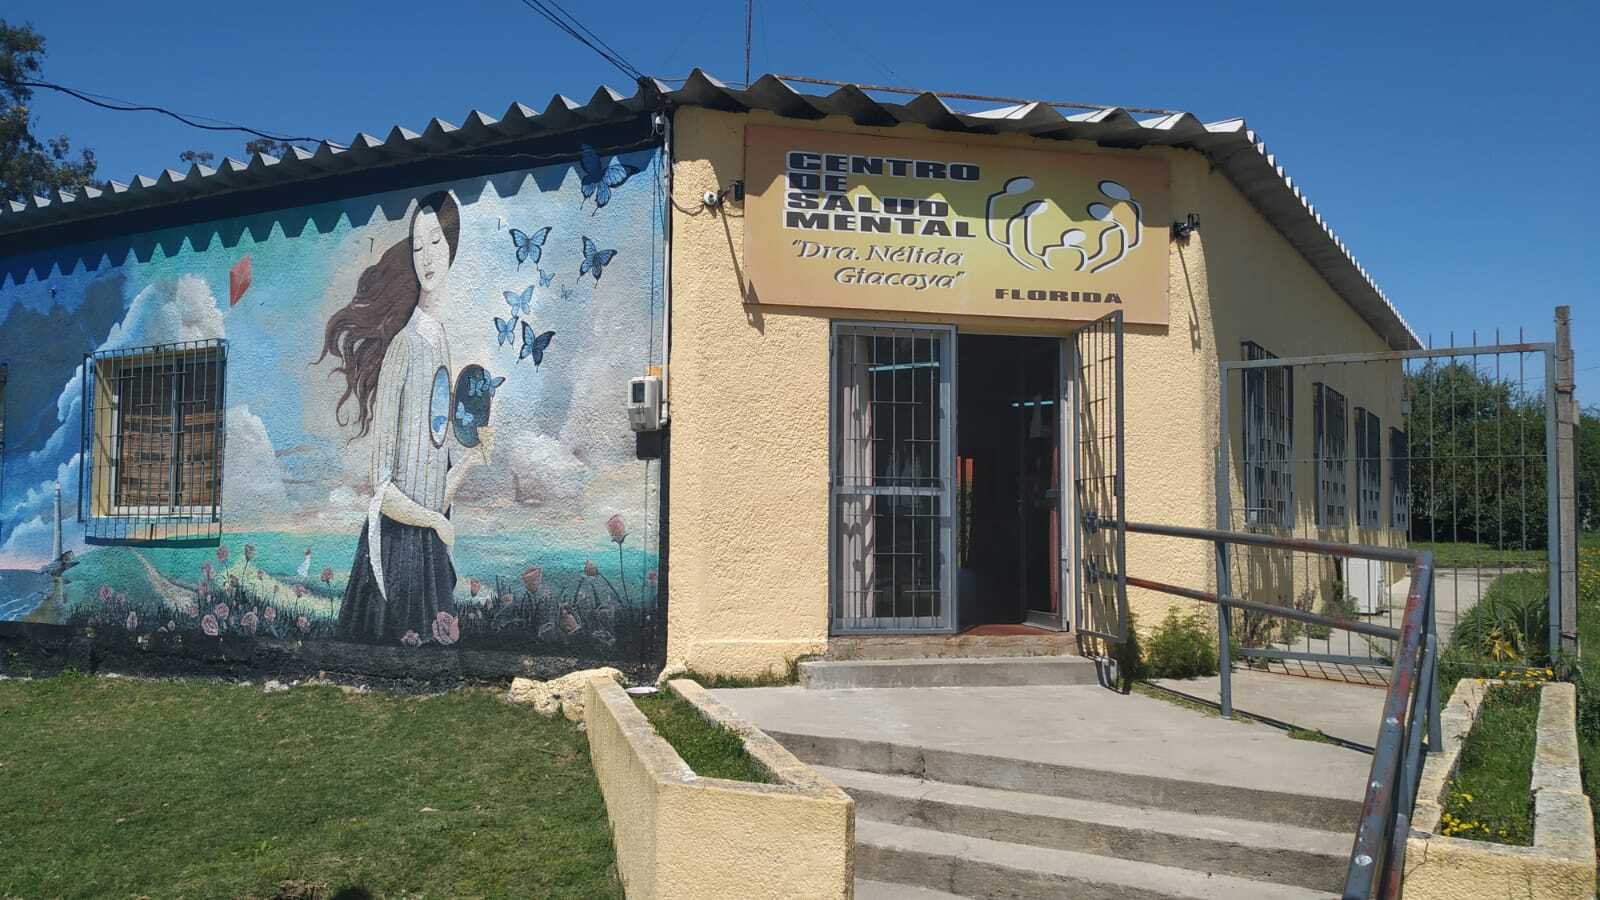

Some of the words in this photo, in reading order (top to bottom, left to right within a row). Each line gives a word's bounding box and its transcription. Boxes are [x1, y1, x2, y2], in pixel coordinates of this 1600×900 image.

[786, 150, 980, 181] CENTRO
[786, 171, 849, 193] DE
[785, 192, 949, 217] SALUD
[783, 209, 977, 238] MENTAL
[865, 243, 964, 267] Nélida
[995, 288, 1123, 304] FLORIDA
